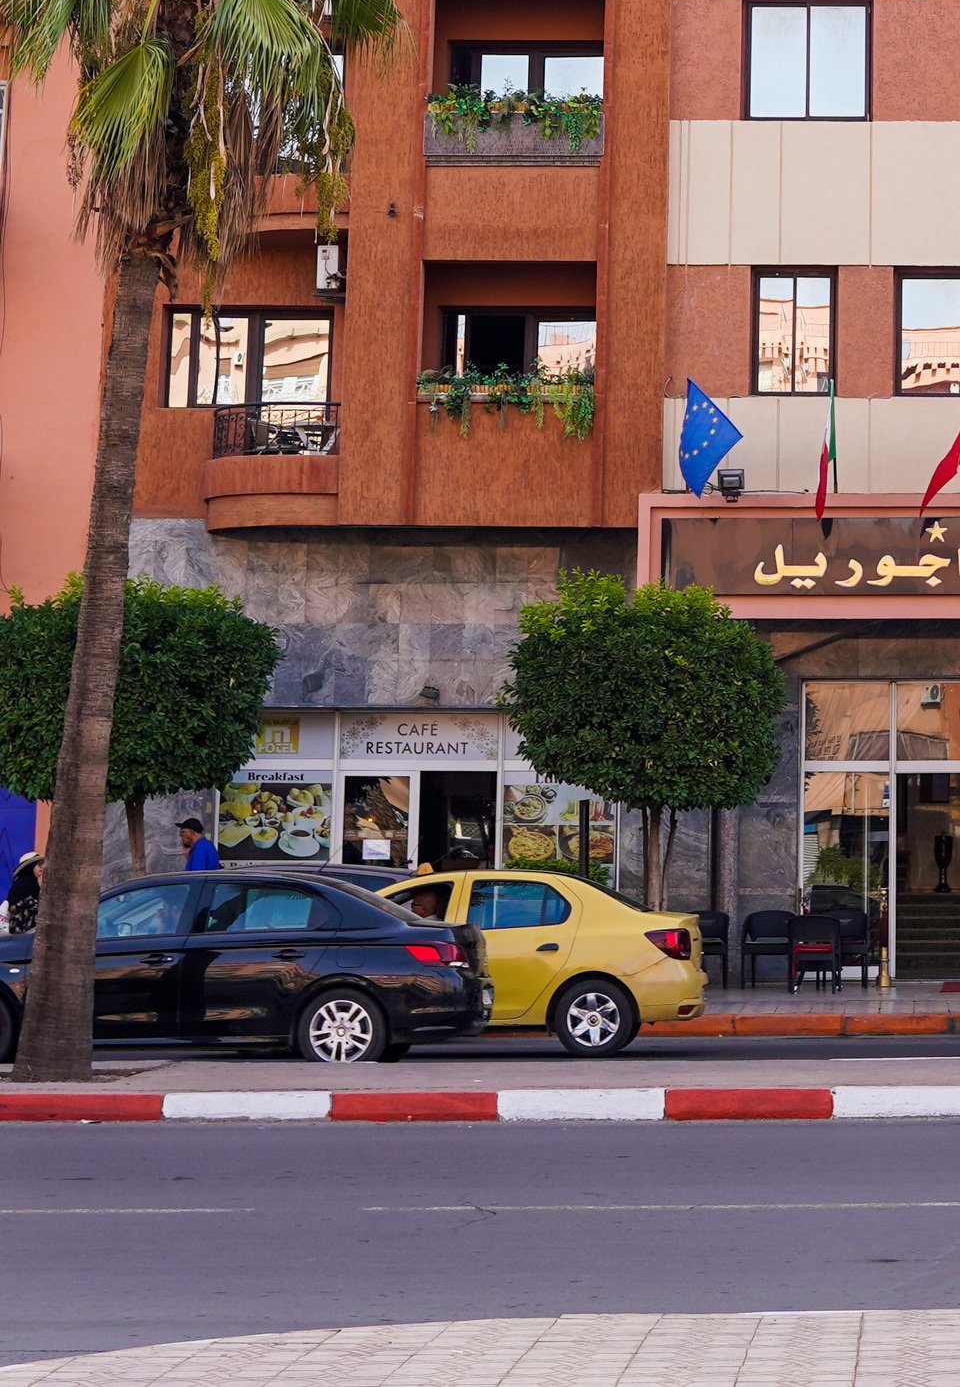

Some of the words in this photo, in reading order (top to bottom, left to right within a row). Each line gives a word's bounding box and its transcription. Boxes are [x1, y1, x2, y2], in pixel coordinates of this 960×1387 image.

[397, 721, 438, 736] CAFÉ
[365, 741, 469, 755] RESTAURANT
[247, 772, 305, 782] Breakfast
